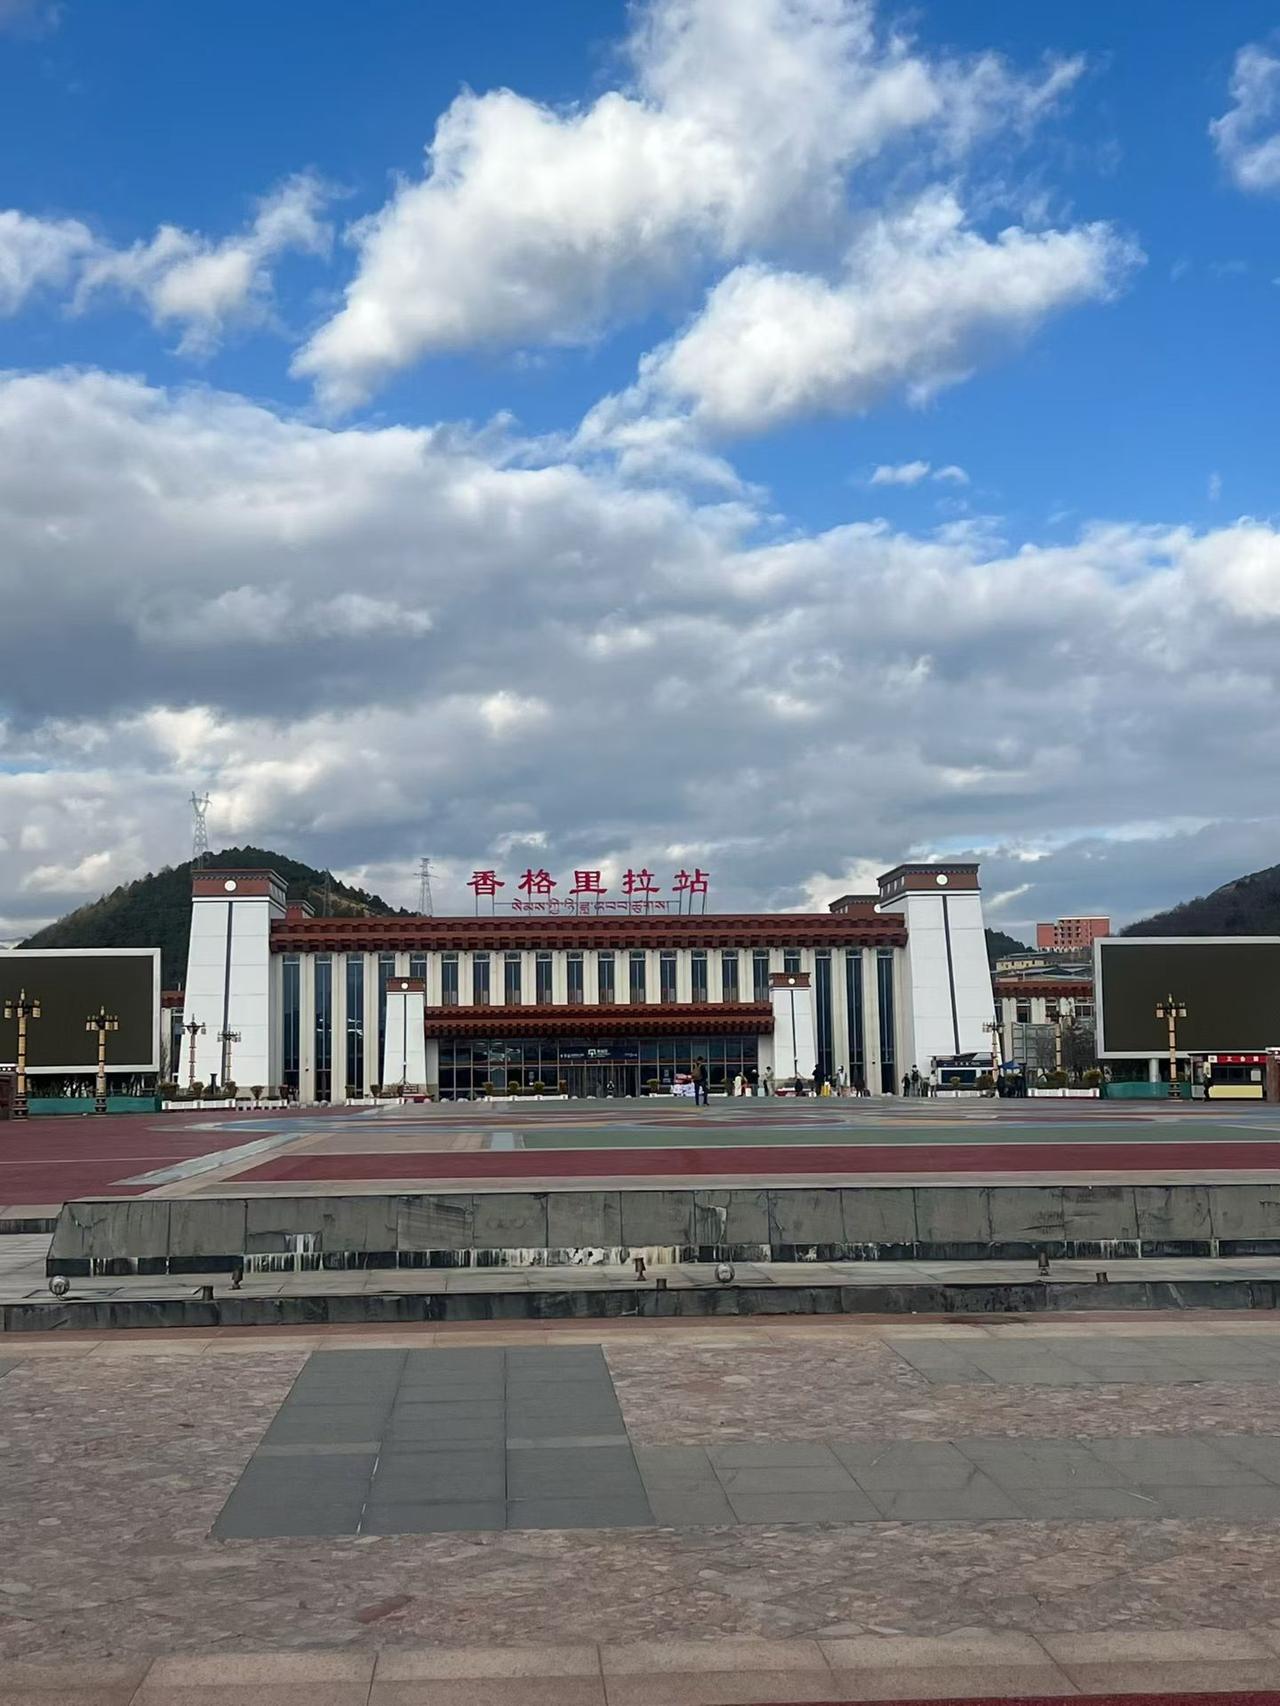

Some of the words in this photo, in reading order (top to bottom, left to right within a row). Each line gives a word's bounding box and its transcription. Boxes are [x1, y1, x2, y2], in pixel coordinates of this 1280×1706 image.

[467, 869, 710, 896] 香格里拉站
